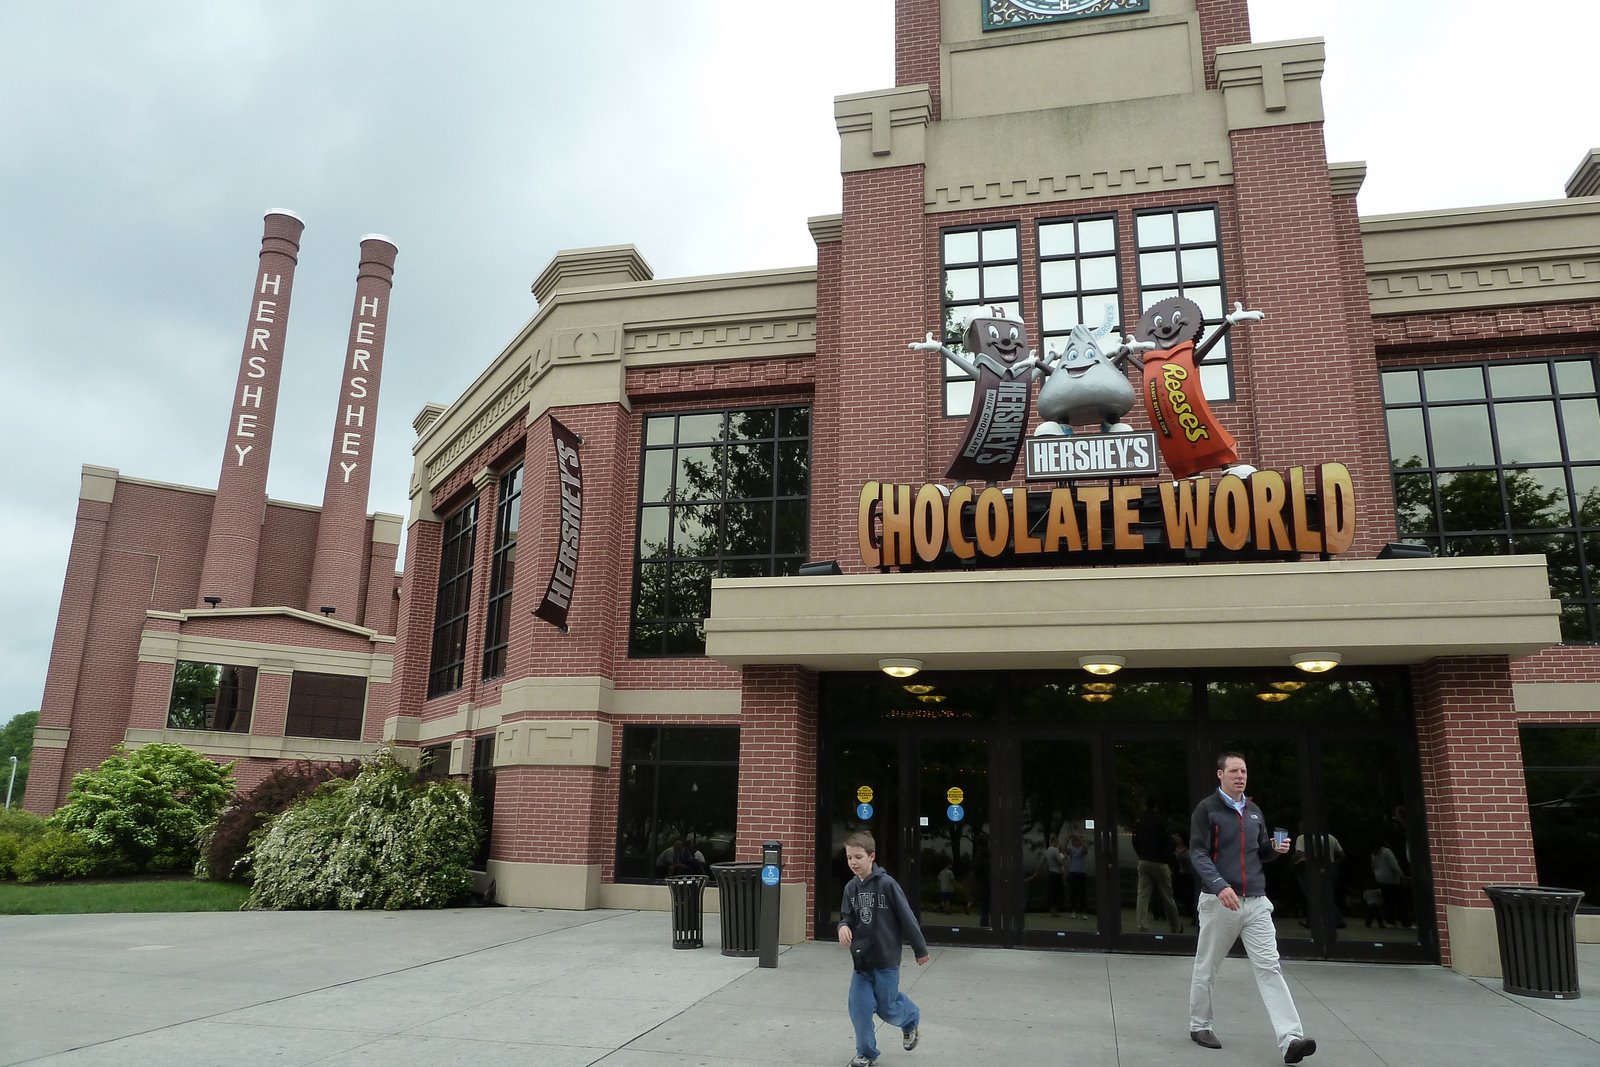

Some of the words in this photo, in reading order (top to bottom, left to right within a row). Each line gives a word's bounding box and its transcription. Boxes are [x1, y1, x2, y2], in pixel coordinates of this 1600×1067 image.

[990, 305, 1006, 319] H
[234, 272, 281, 467] HERSHEY
[340, 295, 379, 483] HERSHEY
[985, 391, 995, 410] MILK
[969, 411, 991, 455] CHOCOLATE
[976, 381, 1027, 465] HERSHEY'S
[1153, 401, 1162, 420] BUTTER
[1160, 421, 1169, 435] CUPS
[1033, 437, 1150, 473] HERSHEY'S
[547, 438, 582, 609] HERSHEY'S
[858, 480, 1145, 568] CHOCOLATE
[1158, 461, 1356, 555] WORLD
